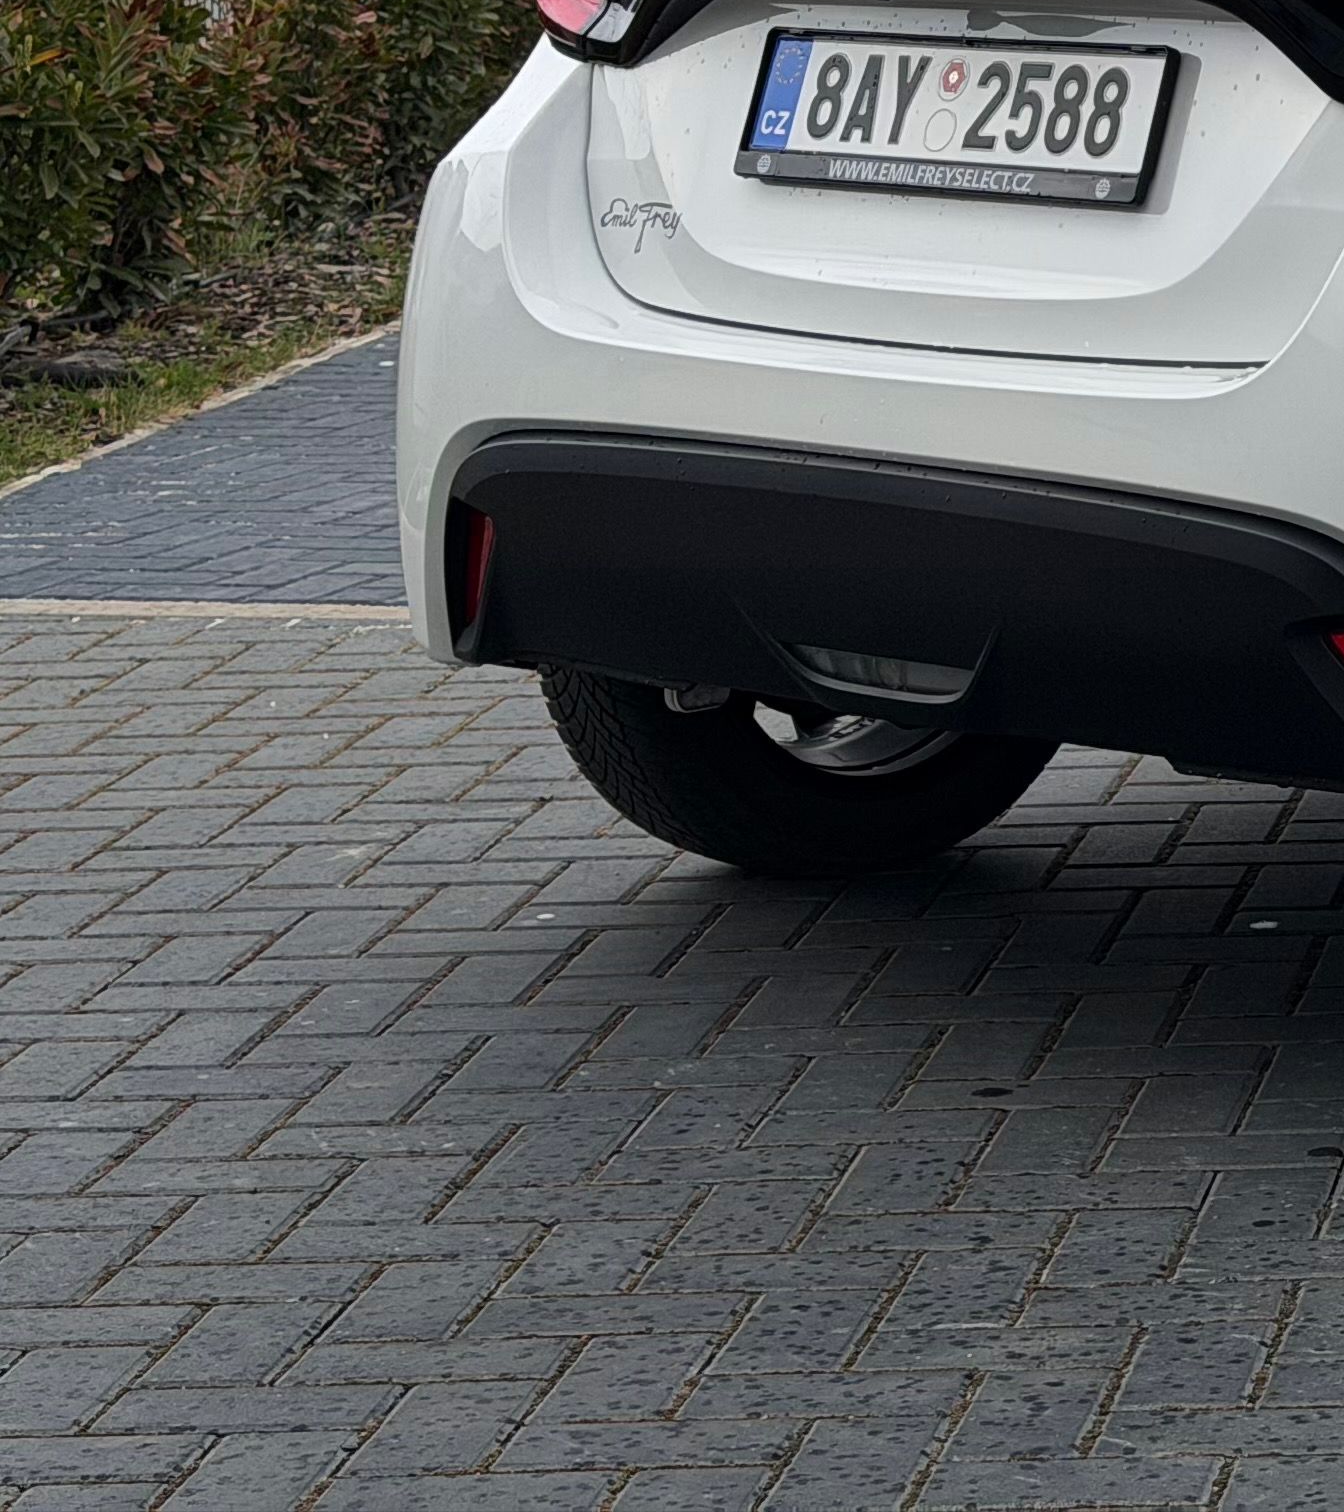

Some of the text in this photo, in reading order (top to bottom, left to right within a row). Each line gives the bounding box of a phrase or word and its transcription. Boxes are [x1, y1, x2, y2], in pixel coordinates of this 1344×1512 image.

[760, 108, 790, 137] CZ
[806, 51, 1130, 158] 8AY 2588
[828, 158, 1035, 193] WWW.EMILFREYSELECT.CZ
[600, 197, 683, 255] Emil Frey
